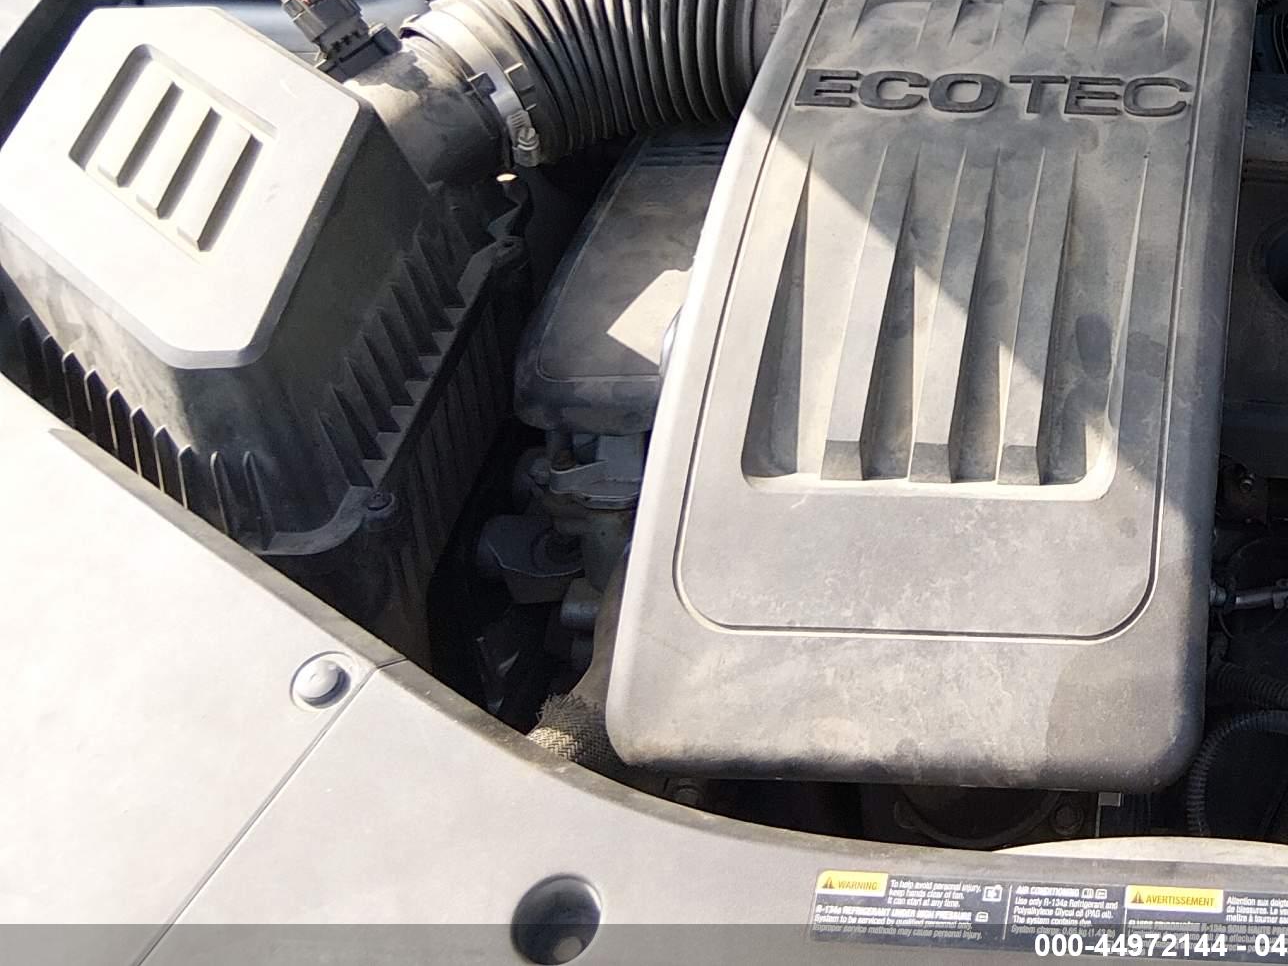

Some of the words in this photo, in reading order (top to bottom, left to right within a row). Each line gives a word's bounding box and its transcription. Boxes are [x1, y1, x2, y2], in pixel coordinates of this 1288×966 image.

[794, 69, 1193, 118] ECOTEC
[838, 880, 878, 890] WARNING
[1145, 895, 1215, 907] AVERTISSEMENT
